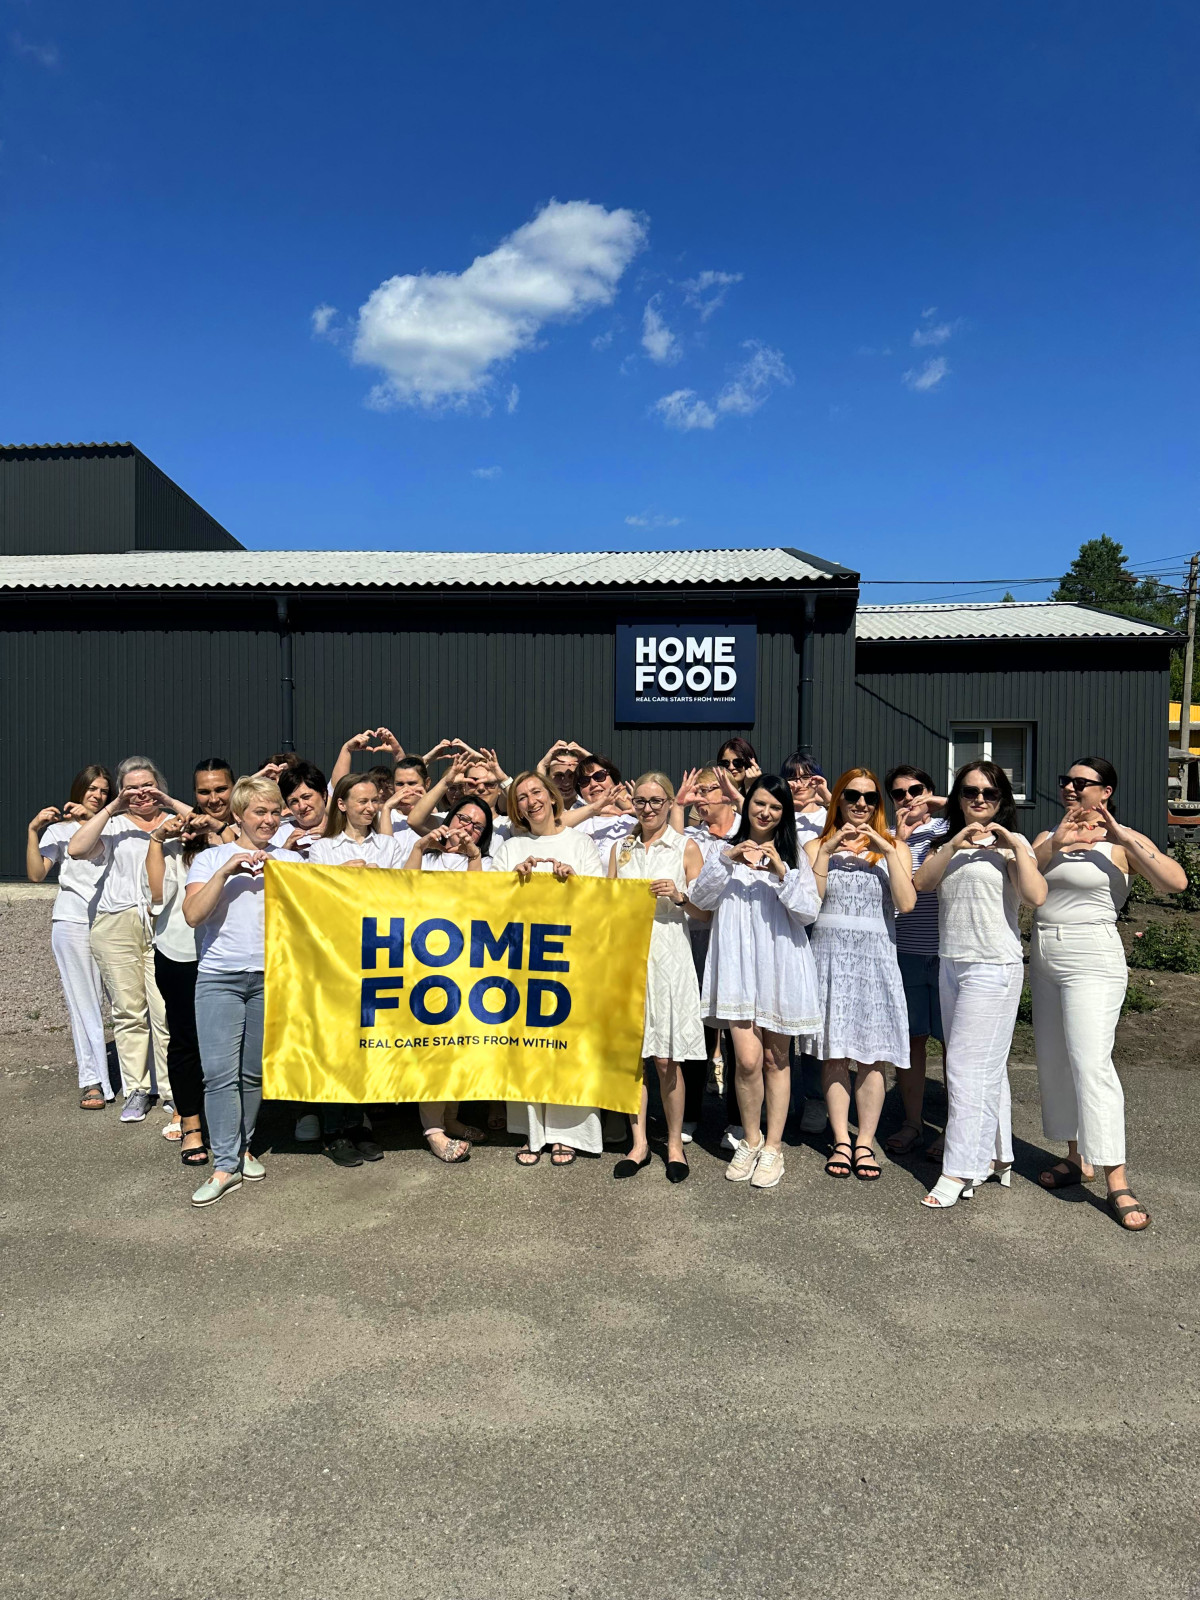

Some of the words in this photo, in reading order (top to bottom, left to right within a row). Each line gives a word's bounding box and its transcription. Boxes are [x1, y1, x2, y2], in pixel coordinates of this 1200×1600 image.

[635, 637, 736, 663] HOME
[635, 665, 737, 692] FOOD
[361, 916, 572, 973] HOME
[360, 974, 572, 1028] FOOD
[359, 1038, 391, 1049] REAL
[394, 1037, 430, 1048] CARE
[432, 1035, 480, 1047] STARTS
[483, 1035, 519, 1047] FROM
[522, 1037, 568, 1050] WITHIN
